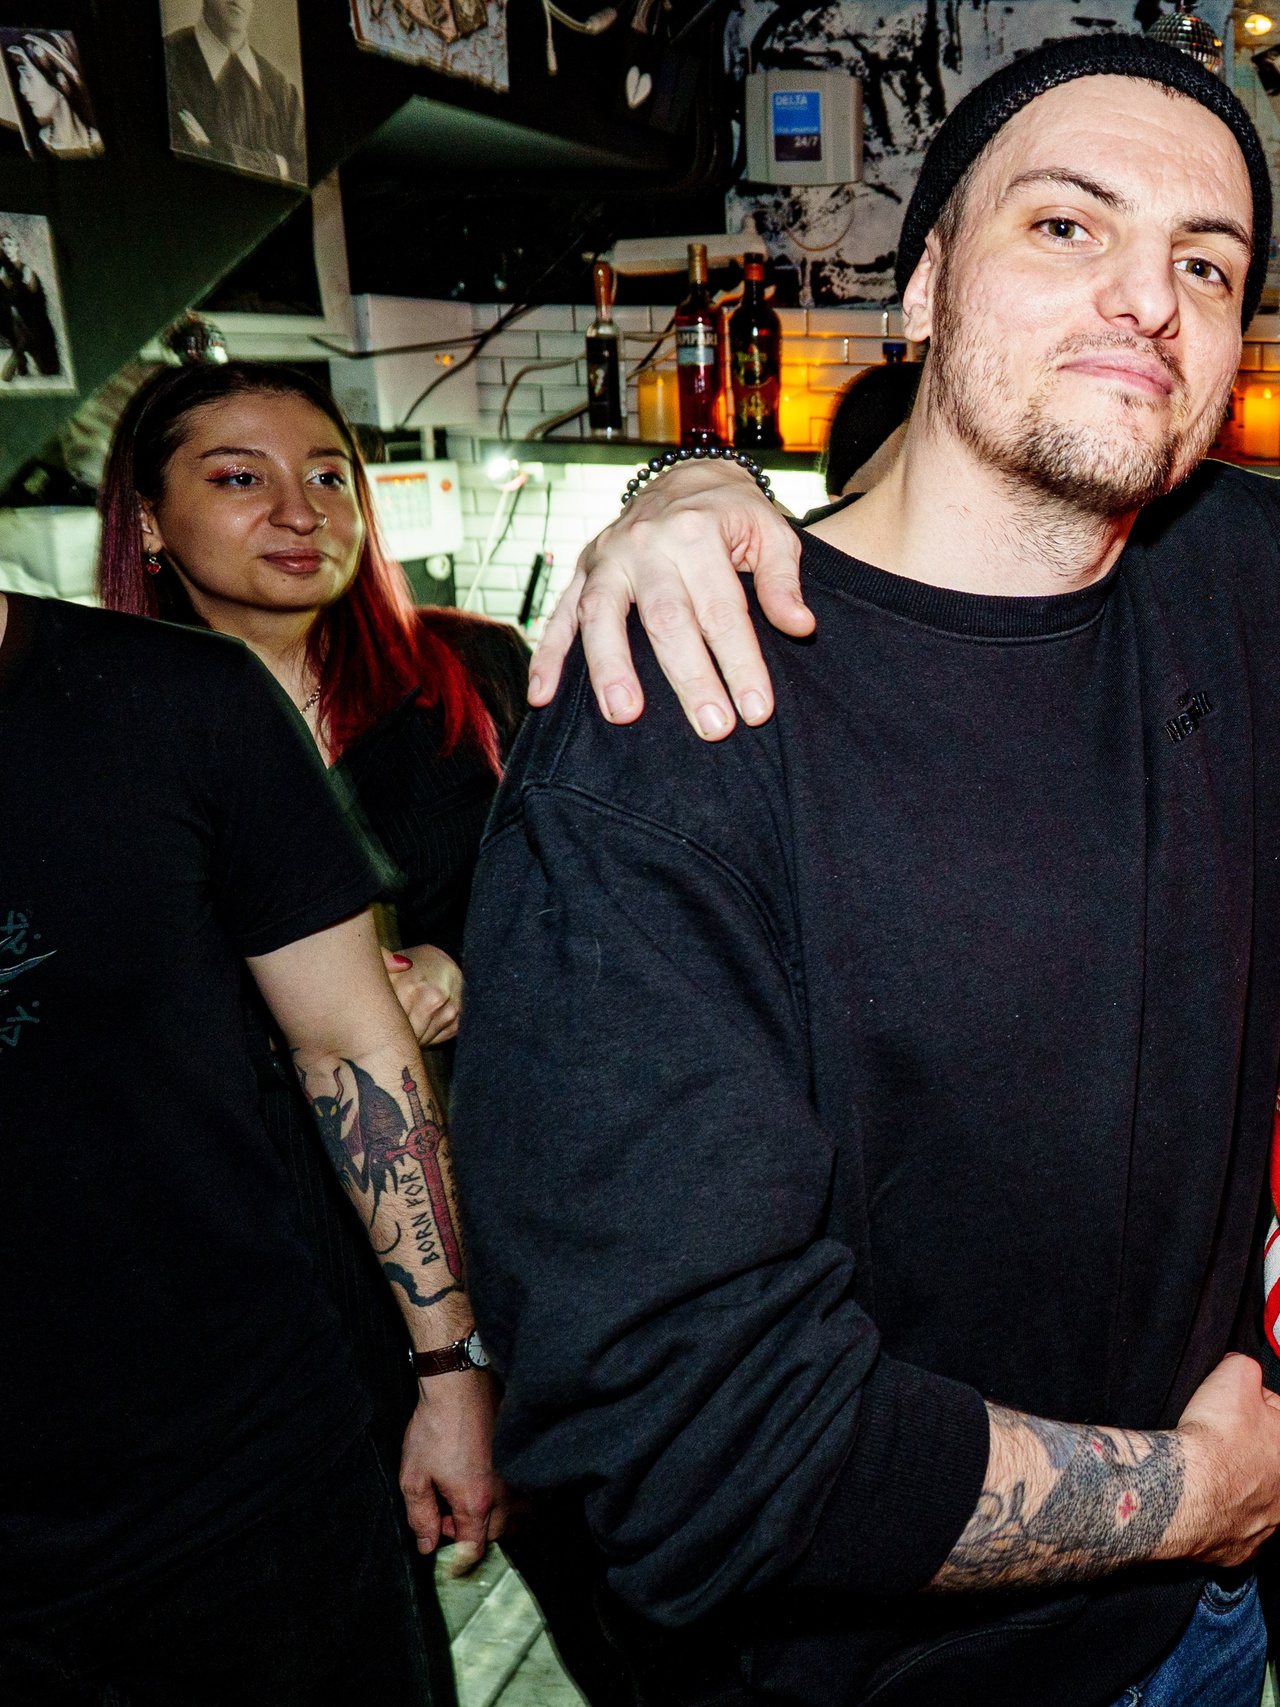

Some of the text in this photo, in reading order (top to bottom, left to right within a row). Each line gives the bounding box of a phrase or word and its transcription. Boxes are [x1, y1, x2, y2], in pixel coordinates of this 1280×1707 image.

[775, 94, 808, 106] DELTA
[794, 135, 819, 148] 24/7
[676, 331, 718, 346] AMPARI
[400, 1167, 440, 1265] BORN FOR
